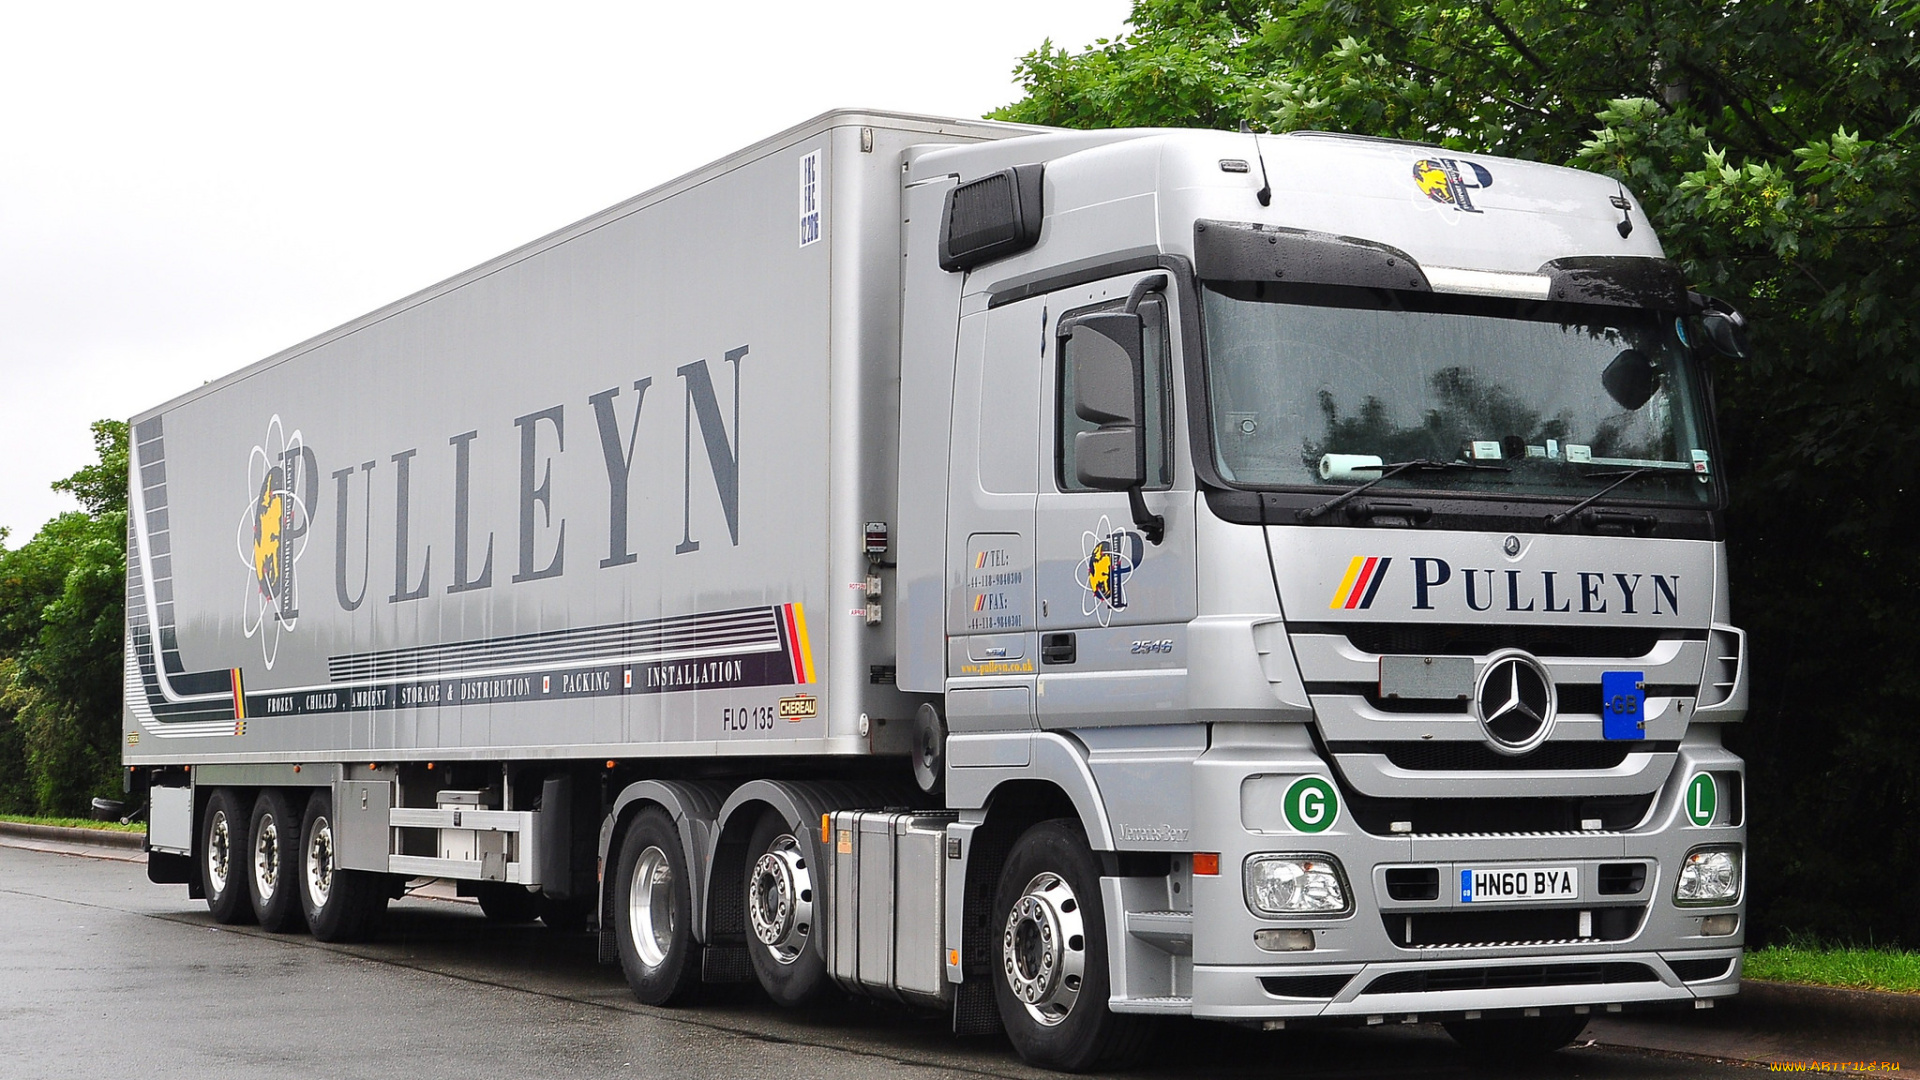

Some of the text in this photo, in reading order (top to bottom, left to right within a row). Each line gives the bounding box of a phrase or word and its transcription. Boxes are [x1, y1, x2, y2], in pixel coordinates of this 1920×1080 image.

[275, 345, 749, 621] PULLEYN
[990, 549, 1009, 567] TEL:
[1410, 557, 1680, 616] PULLEYN
[988, 593, 1007, 610] FAX:
[1130, 639, 1173, 655] 2546
[961, 658, 1033, 675] www.pulleyn.co.uk
[267, 697, 294, 713] FROZEN
[306, 694, 338, 710] CHILLED
[351, 690, 387, 708] AMBIENT
[402, 684, 441, 704] STORAGE
[447, 684, 454, 701] &
[461, 677, 530, 700] DISTRIBUTION
[562, 671, 610, 693] PACKING
[647, 660, 742, 687] INSTALLATION
[780, 700, 815, 715] CHEREAU
[1612, 694, 1638, 714] GB
[723, 706, 774, 731] FLO 135
[1299, 787, 1325, 825] G
[1694, 783, 1709, 818] L
[1475, 871, 1572, 896] HN60 BYA
